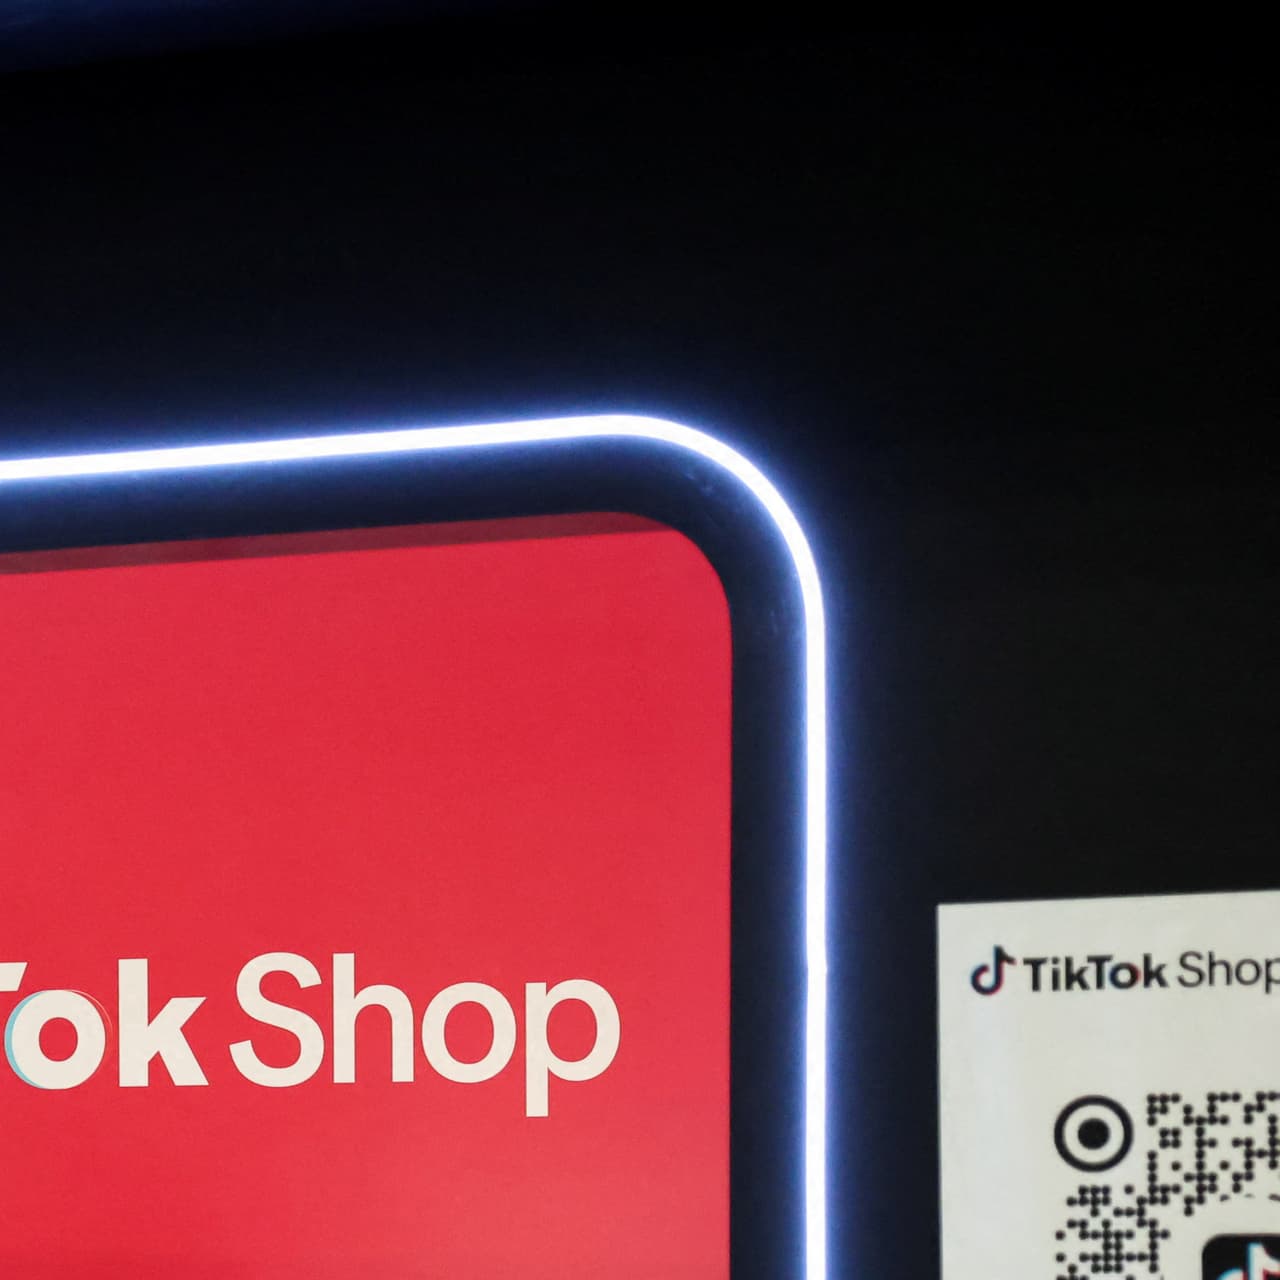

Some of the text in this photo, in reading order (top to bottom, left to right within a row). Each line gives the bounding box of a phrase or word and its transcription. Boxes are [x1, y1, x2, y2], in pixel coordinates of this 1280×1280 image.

[1023, 950, 1280, 995] TikTok Shop
[228, 950, 622, 1118] Shop
